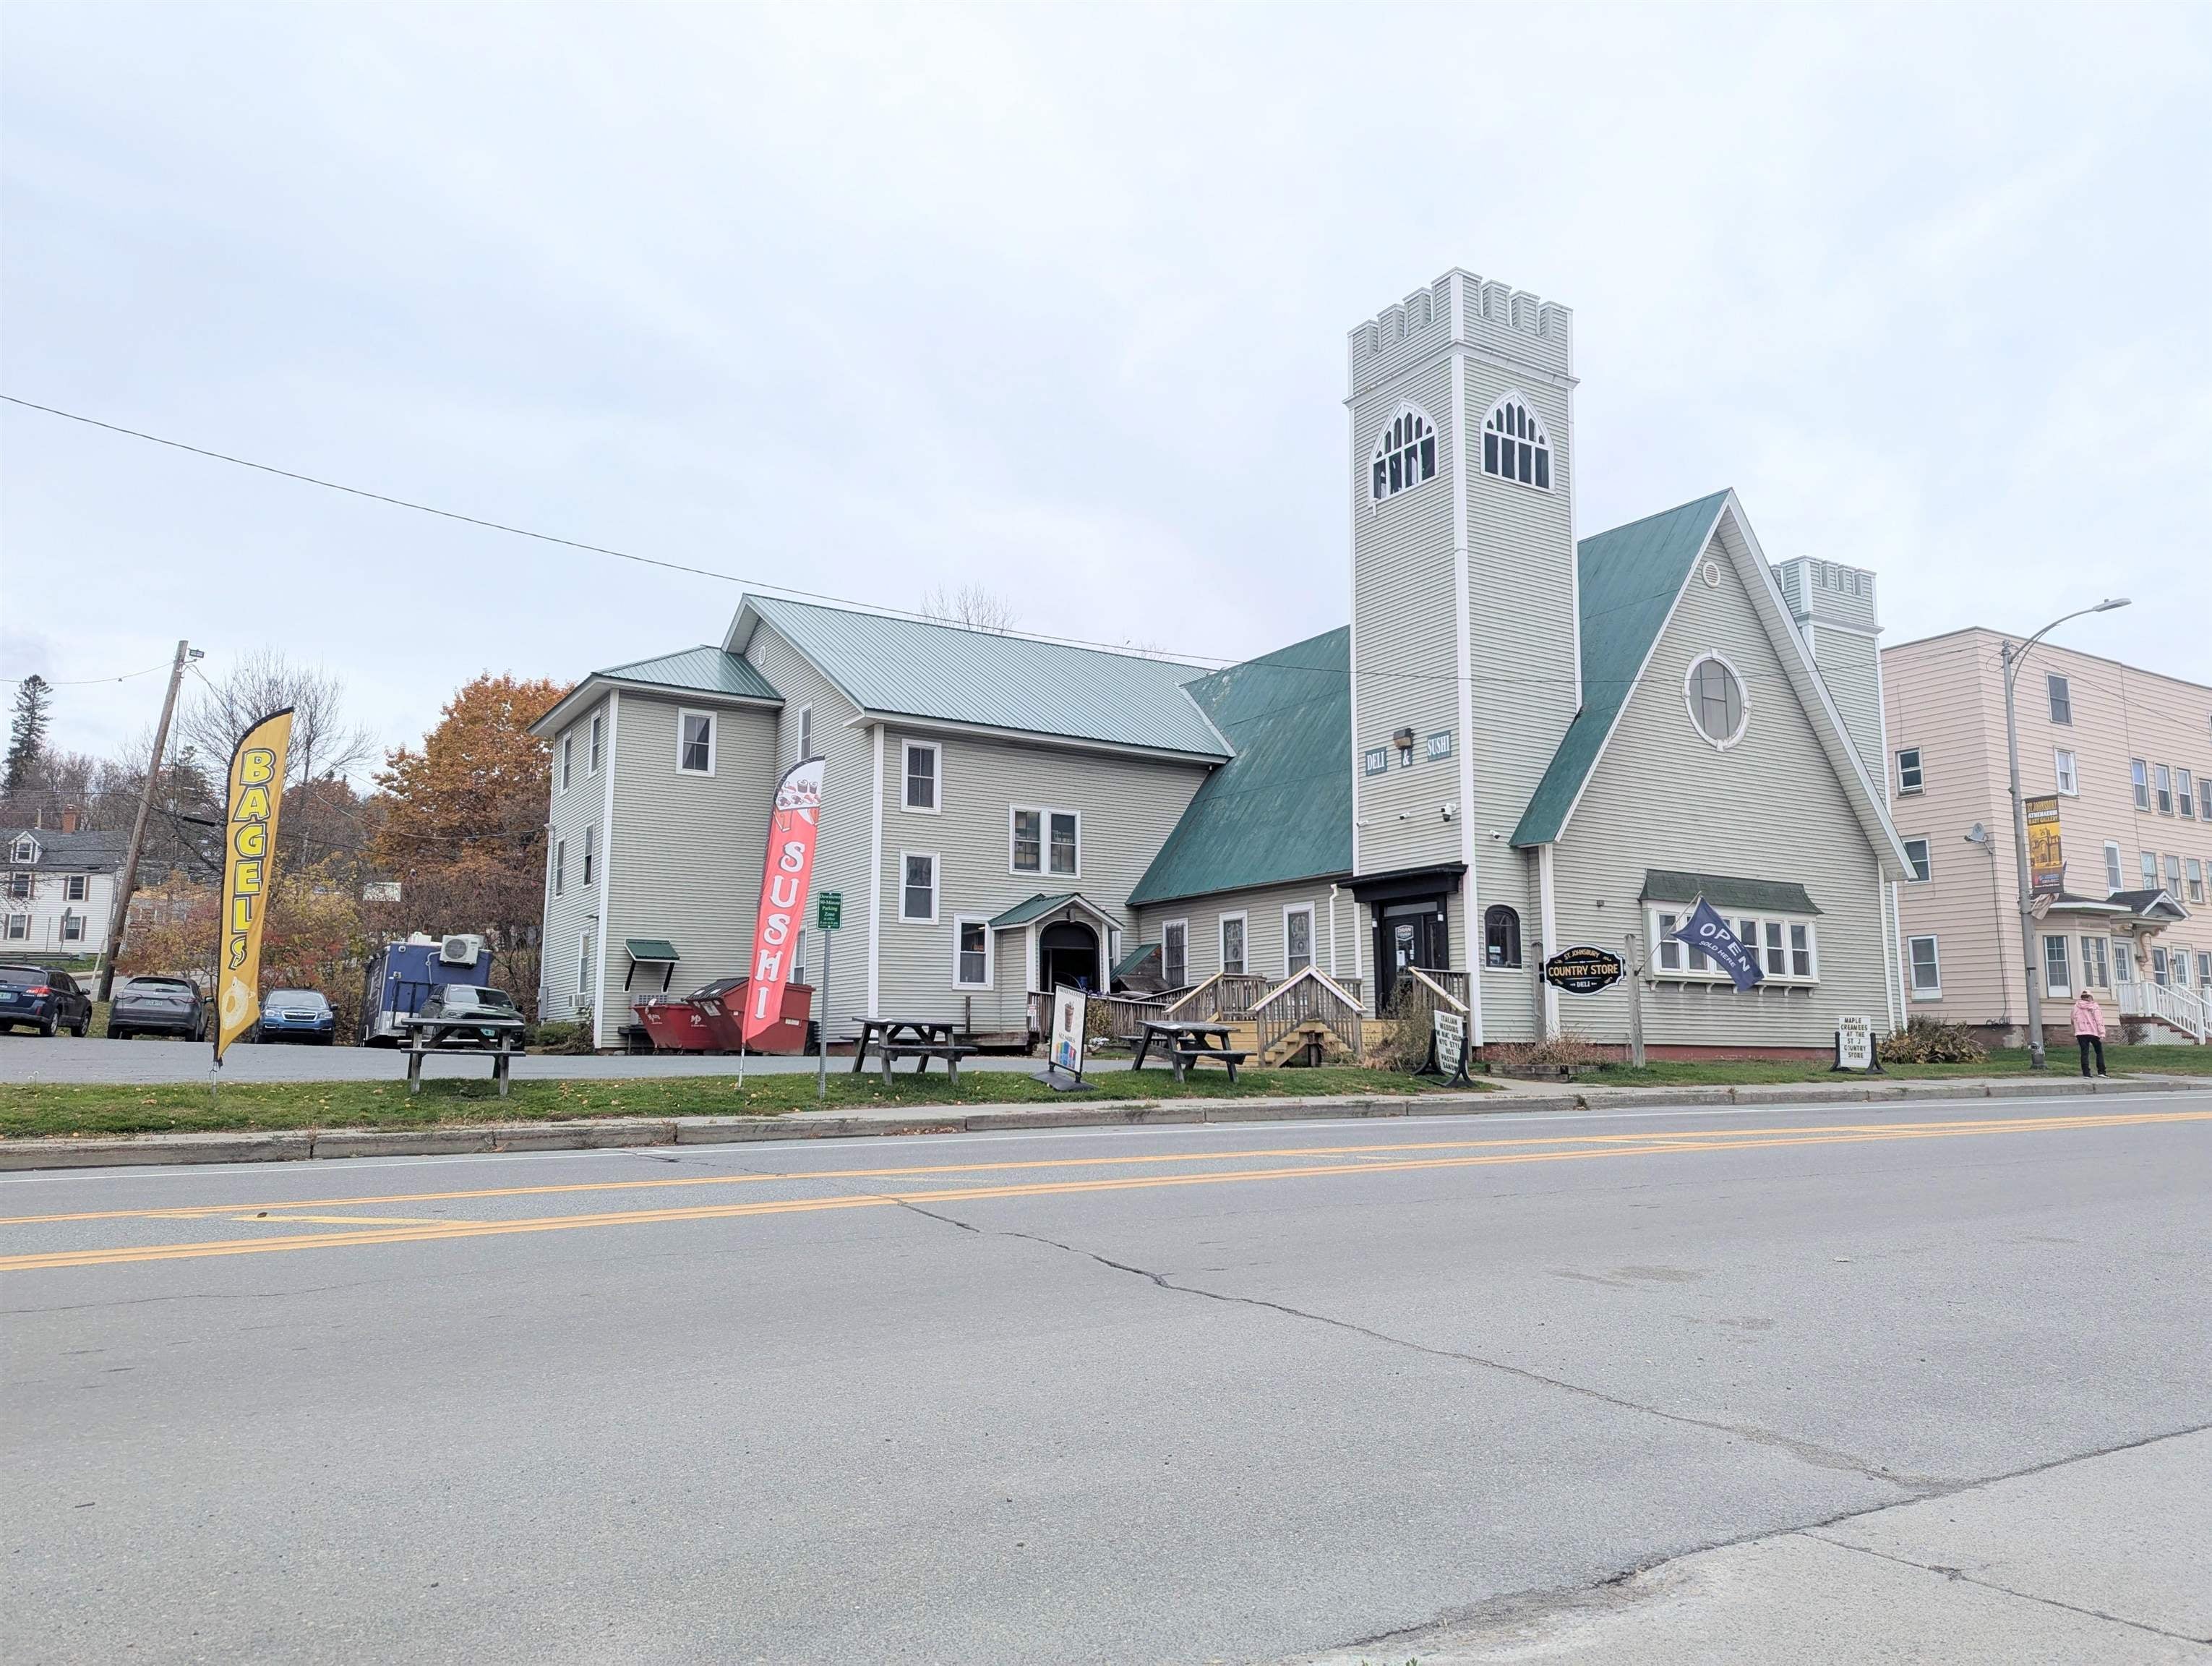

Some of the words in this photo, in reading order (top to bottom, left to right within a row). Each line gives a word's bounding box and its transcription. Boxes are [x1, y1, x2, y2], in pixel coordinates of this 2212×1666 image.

[1367, 751, 1385, 771] DELI
[1402, 749, 1410, 766] &
[1427, 735, 1450, 756] SUSHI
[228, 748, 277, 970] BAGELS
[755, 841, 805, 1019] SUSHI
[1572, 949, 1600, 958] JOHNSBURY
[1699, 923, 1751, 972] OPEN
[1699, 941, 1718, 951] SOLD
[1718, 949, 1736, 968] HERE
[1548, 965, 1588, 977] COUNTRY
[1590, 964, 1619, 975] STORE
[1441, 1015, 1457, 1025] ITALIAN
[1440, 1022, 1459, 1034] WEDDING
[1450, 1041, 1461, 1050] STYL
[1441, 1054, 1457, 1064] PASTRA
